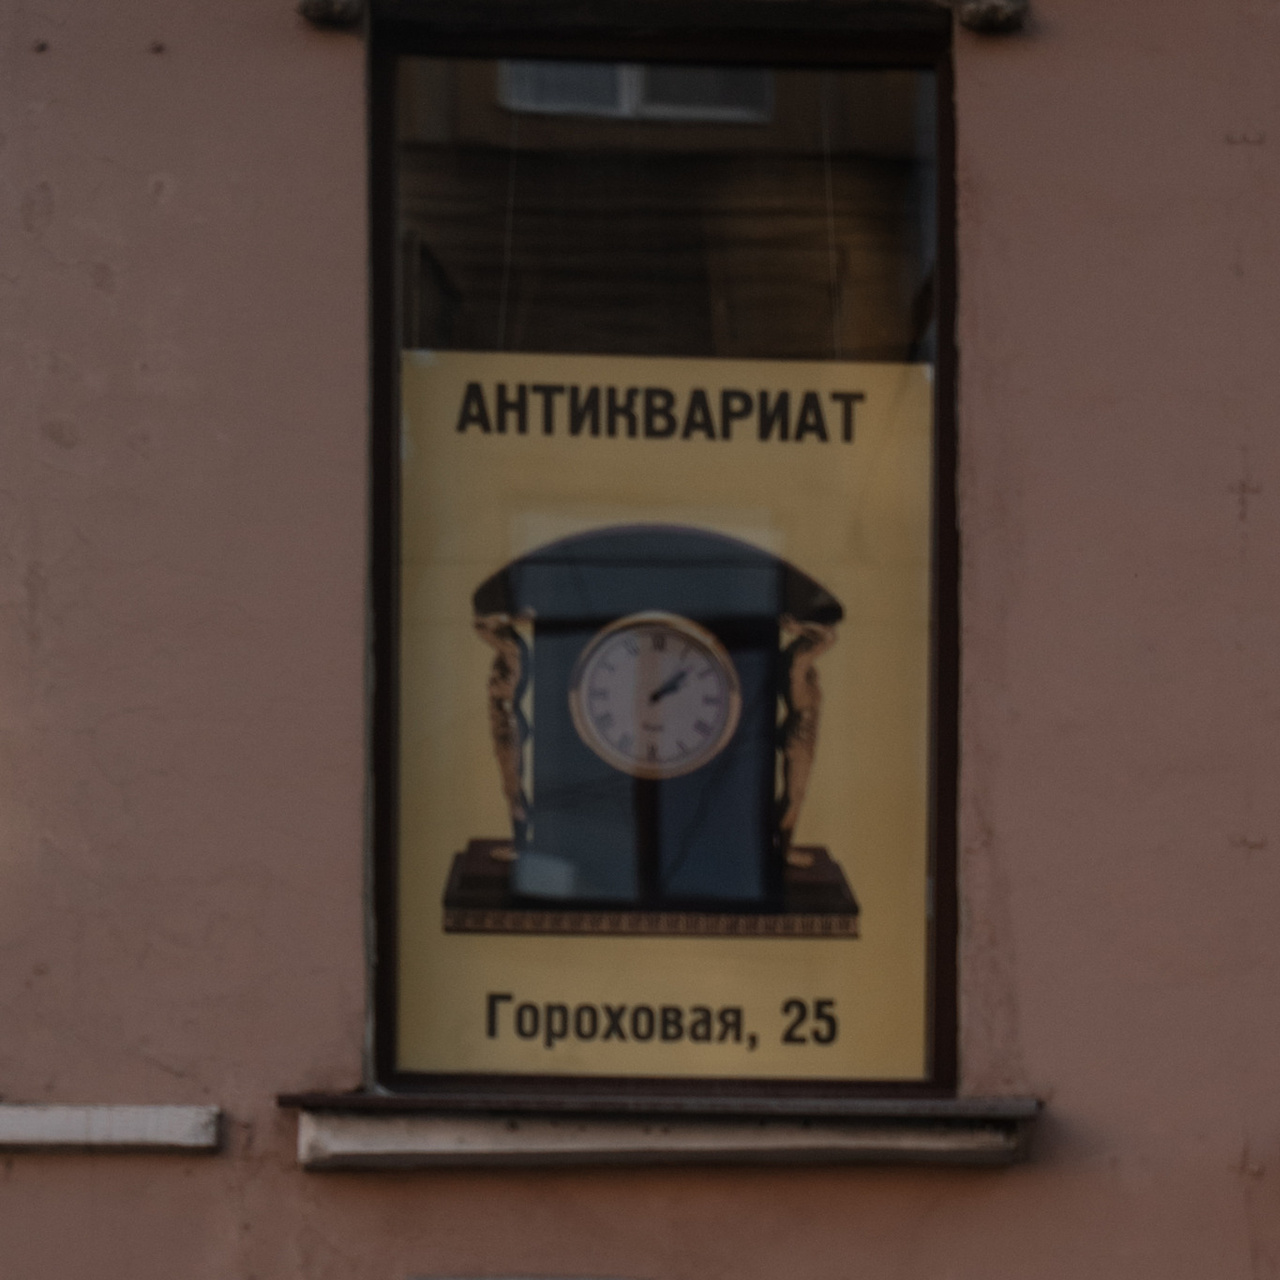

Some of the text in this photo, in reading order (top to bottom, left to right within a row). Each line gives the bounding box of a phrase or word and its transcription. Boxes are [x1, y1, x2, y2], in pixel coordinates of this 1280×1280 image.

[455, 381, 867, 444] АНТИКВАРИАТ
[484, 993, 840, 1050] Гороховая, 25
